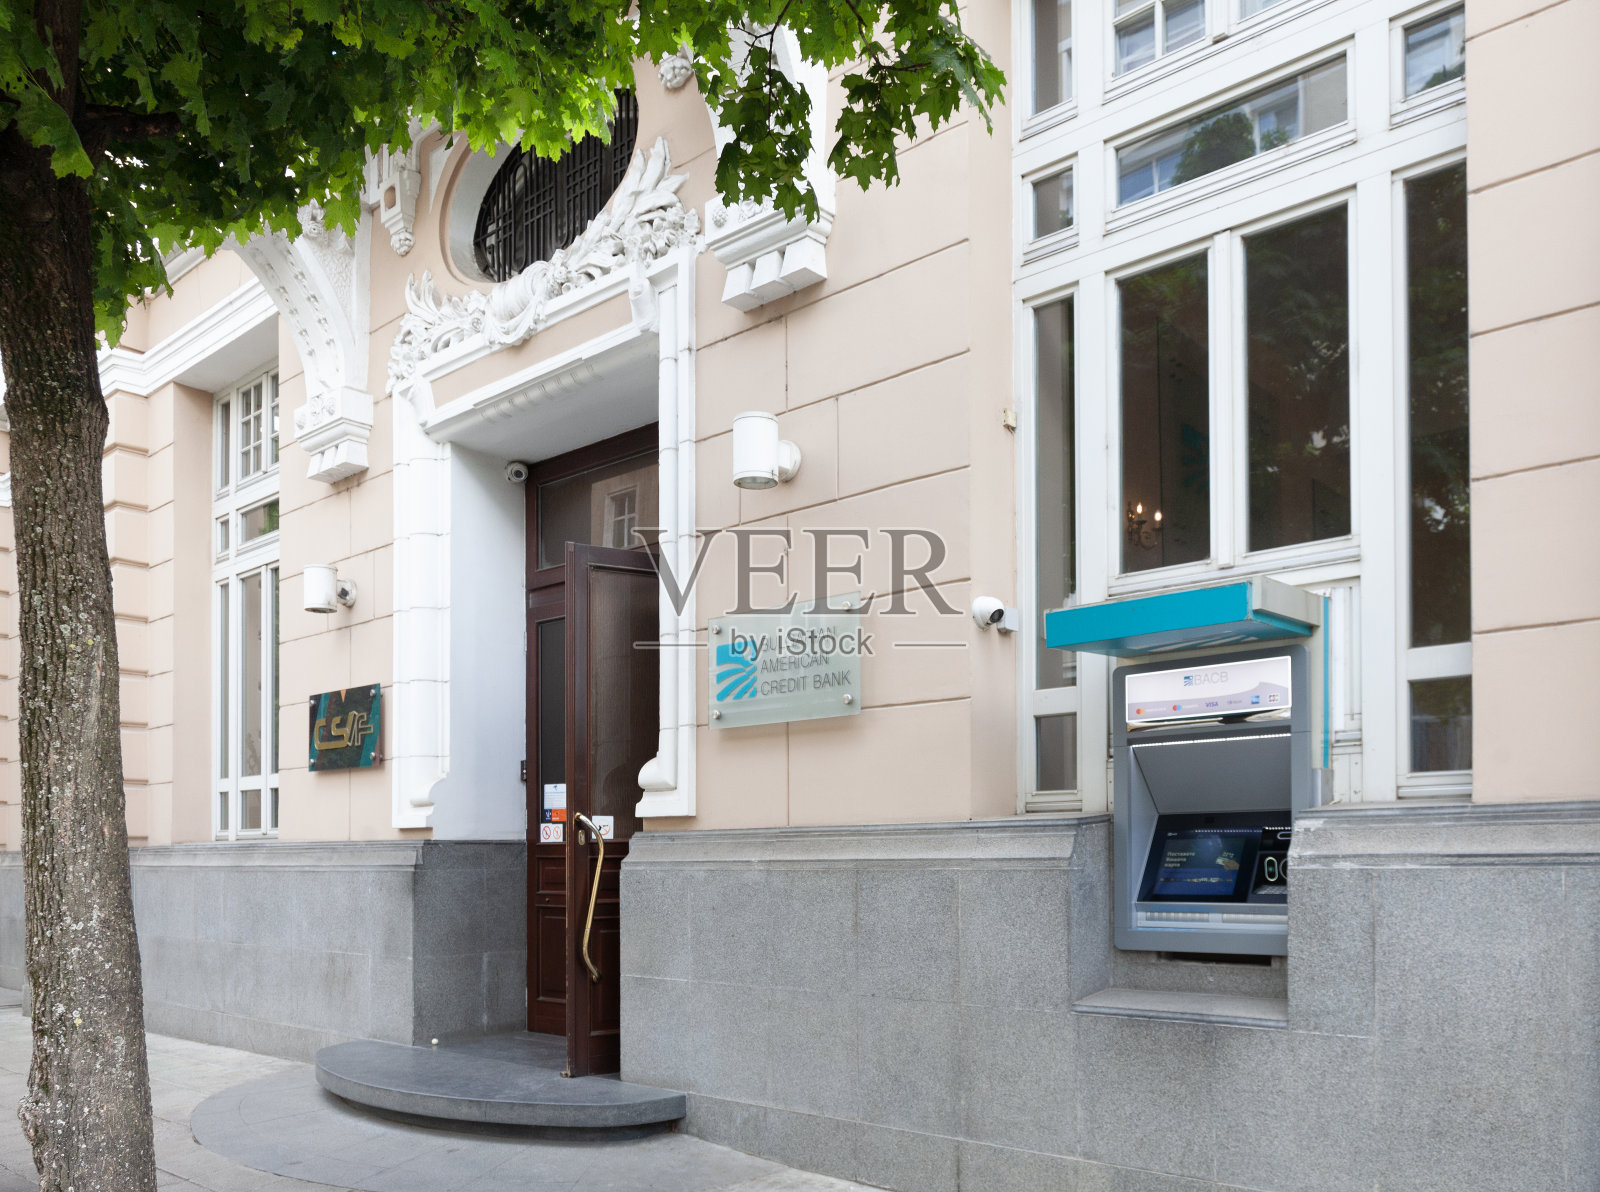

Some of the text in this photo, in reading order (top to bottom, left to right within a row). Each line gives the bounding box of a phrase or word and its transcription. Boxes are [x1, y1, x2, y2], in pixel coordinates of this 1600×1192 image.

[762, 626, 837, 651] BULAN
[760, 652, 830, 674] AMERICAN
[761, 670, 852, 696] CREDIT BANK
[1194, 671, 1229, 686] BACB
